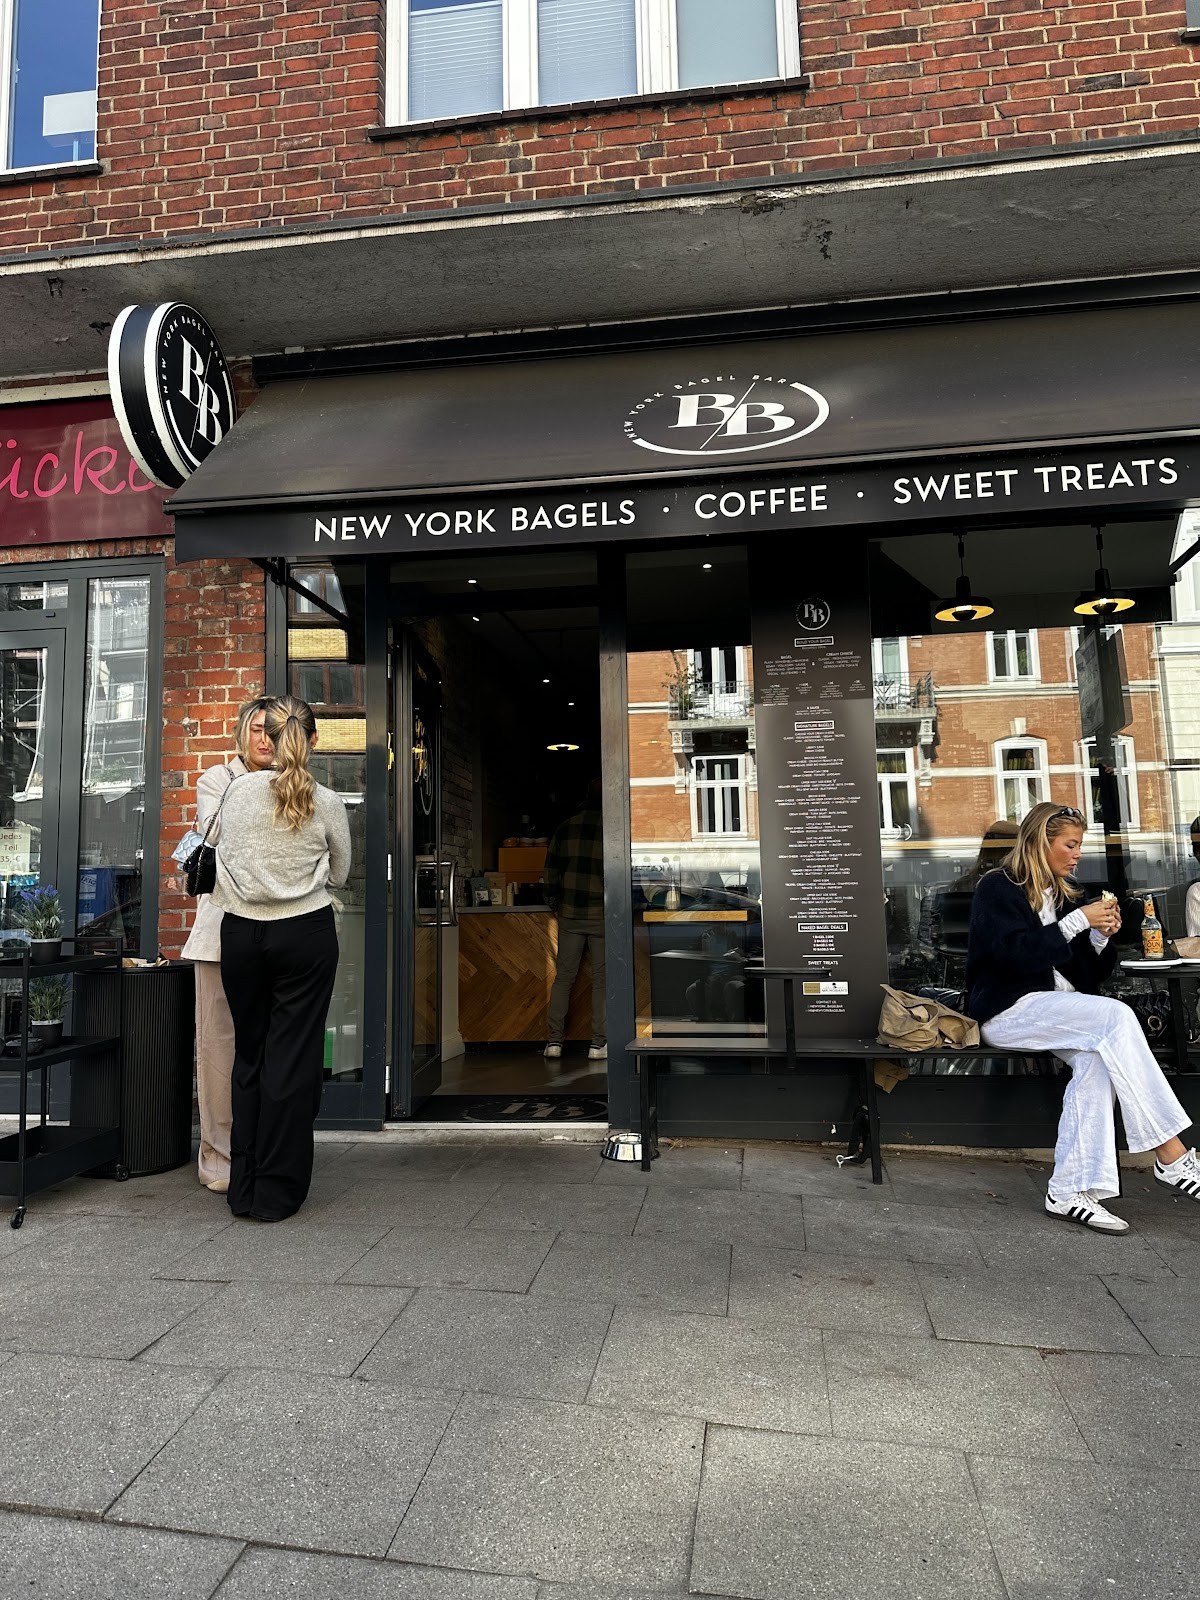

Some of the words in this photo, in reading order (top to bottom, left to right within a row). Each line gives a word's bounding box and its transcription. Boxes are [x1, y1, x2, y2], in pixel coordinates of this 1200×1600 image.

[163, 319, 179, 348] YORK
[181, 315, 207, 336] BAGEL
[674, 375, 736, 391] BAGEL
[751, 374, 787, 385] BAR
[629, 391, 664, 416] YORK
[624, 420, 637, 439] NEW
[314, 514, 392, 542] NEW
[404, 508, 497, 537] YORK
[511, 499, 637, 532] BAGELS
[694, 484, 828, 520] COFFEE
[893, 469, 1020, 505] SWEET
[1033, 457, 1179, 493] TREATS
